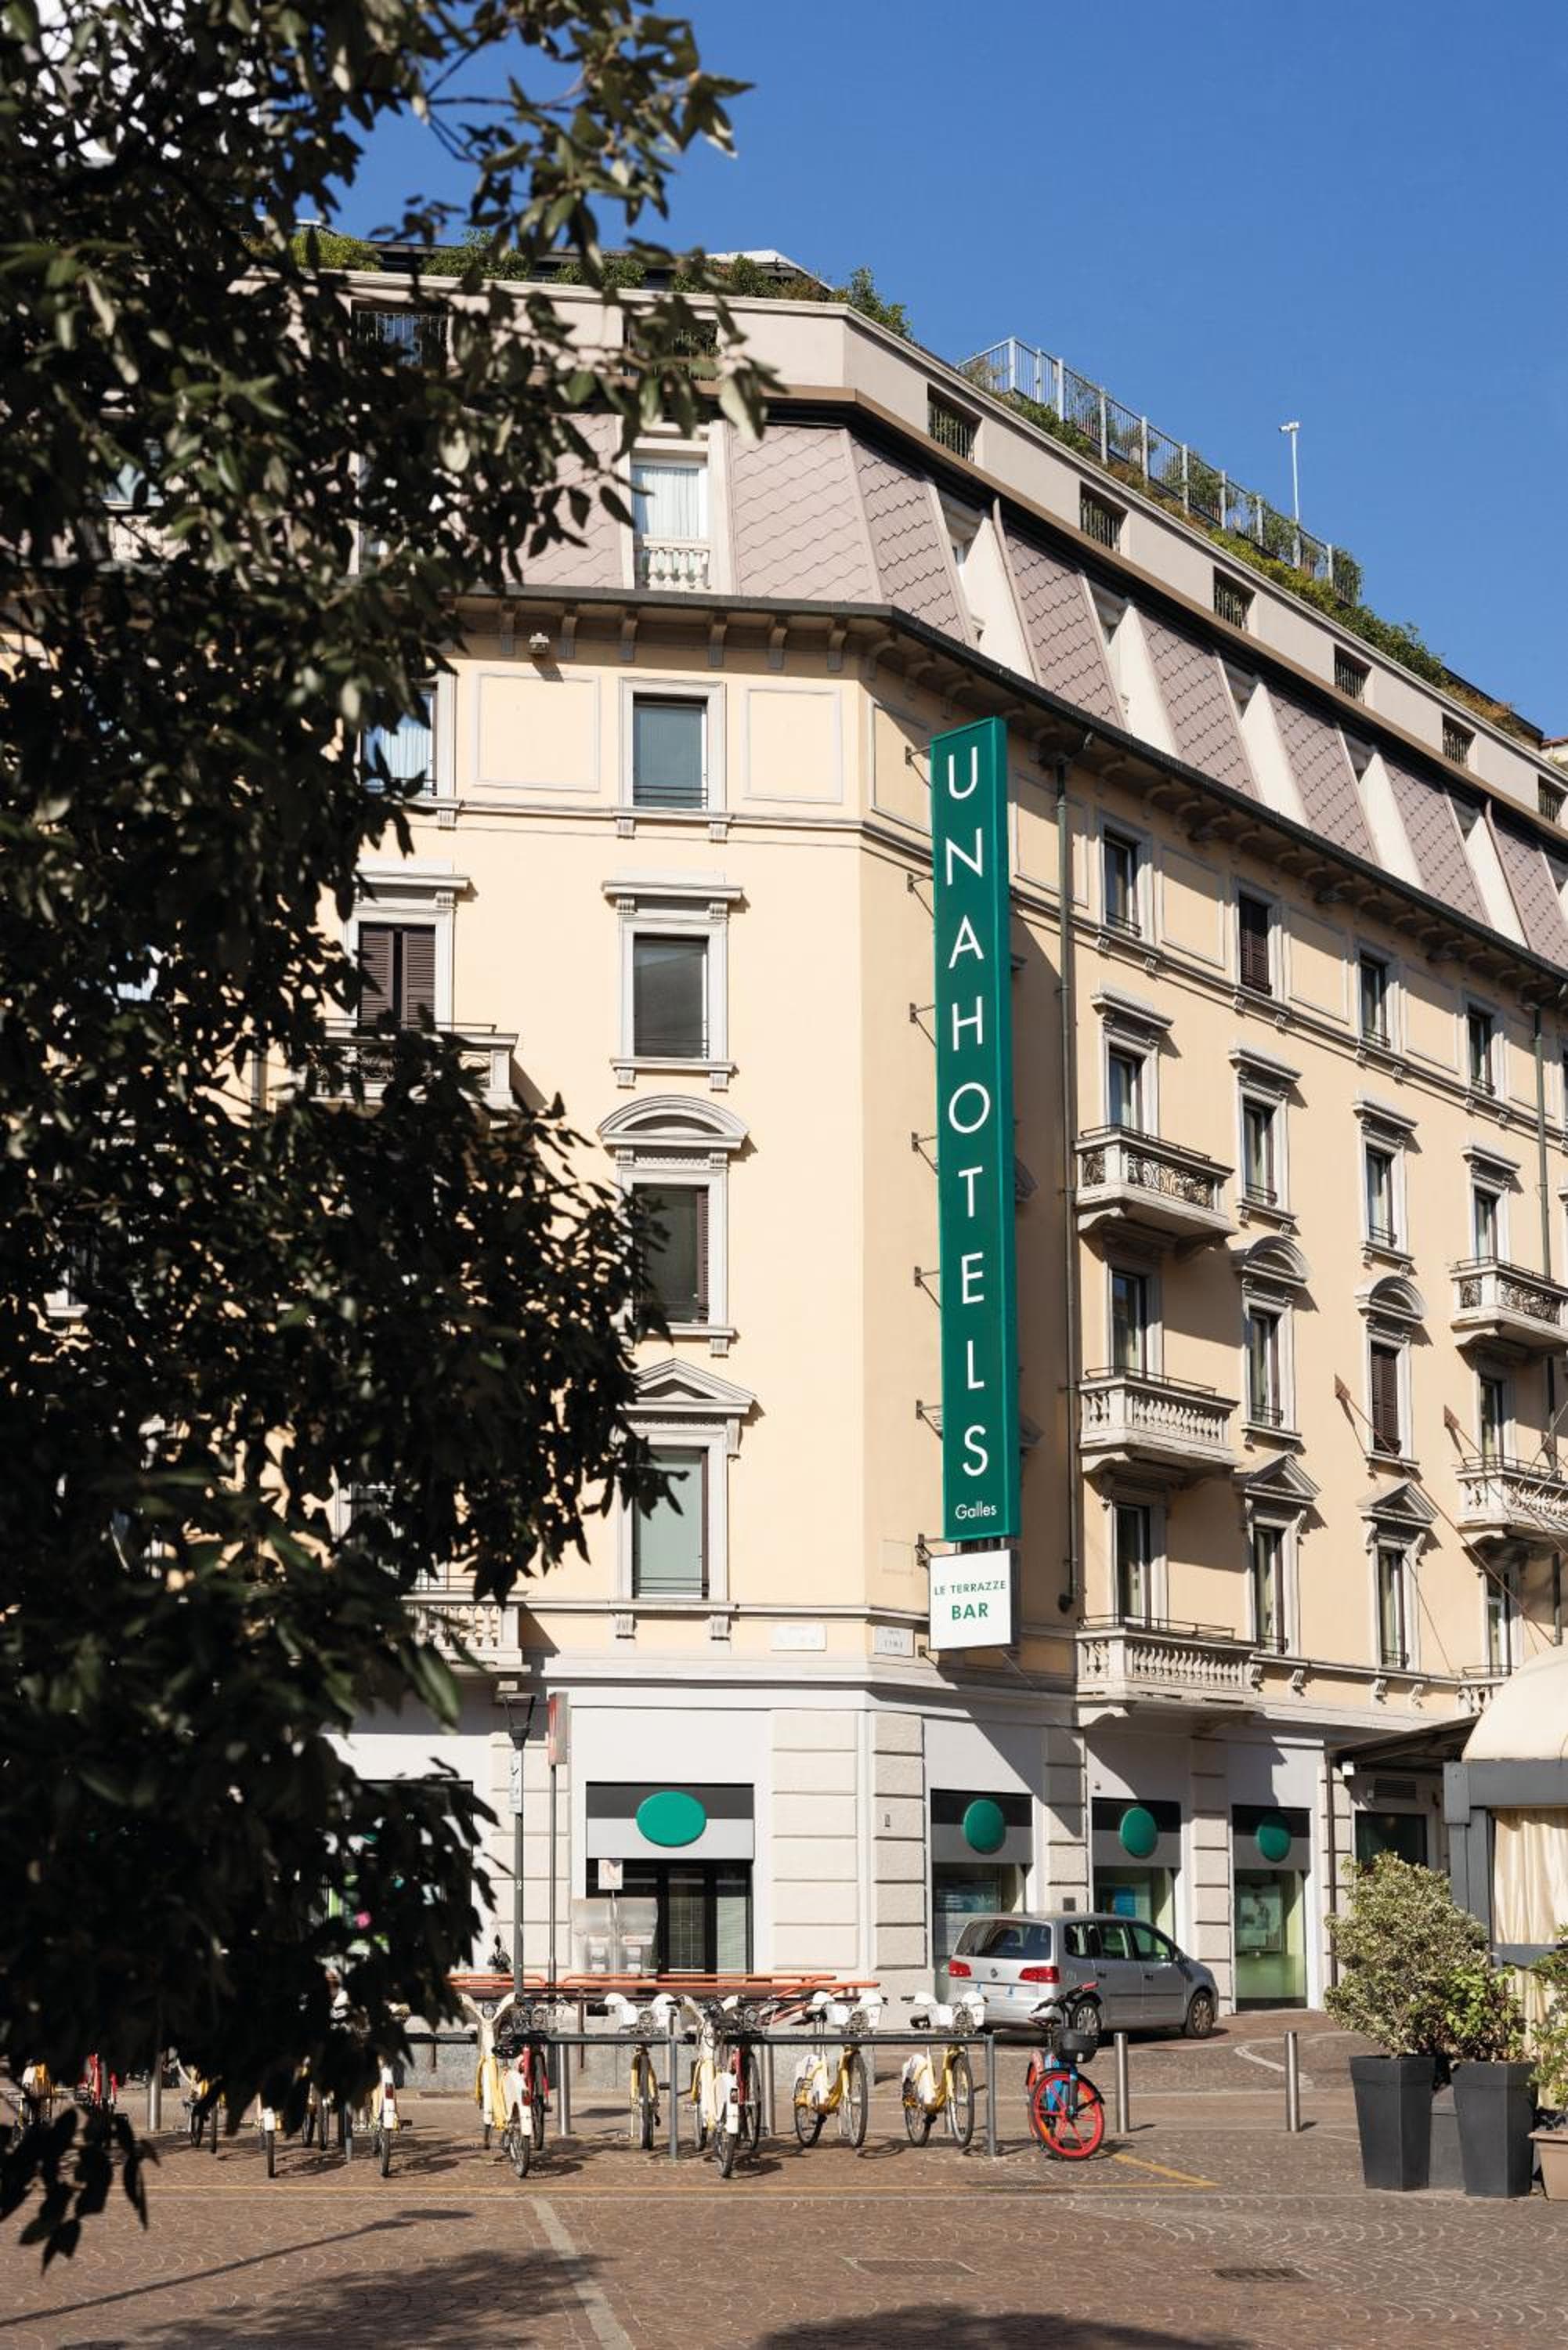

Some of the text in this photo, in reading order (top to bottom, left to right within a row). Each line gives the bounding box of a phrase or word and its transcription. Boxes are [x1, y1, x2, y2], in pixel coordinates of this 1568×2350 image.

[945, 746, 991, 1477] UNAHOTELS
[955, 1501, 997, 1520] Galles
[934, 1580, 1006, 1596] LE TERRAZZE
[952, 1602, 988, 1621] BAR
